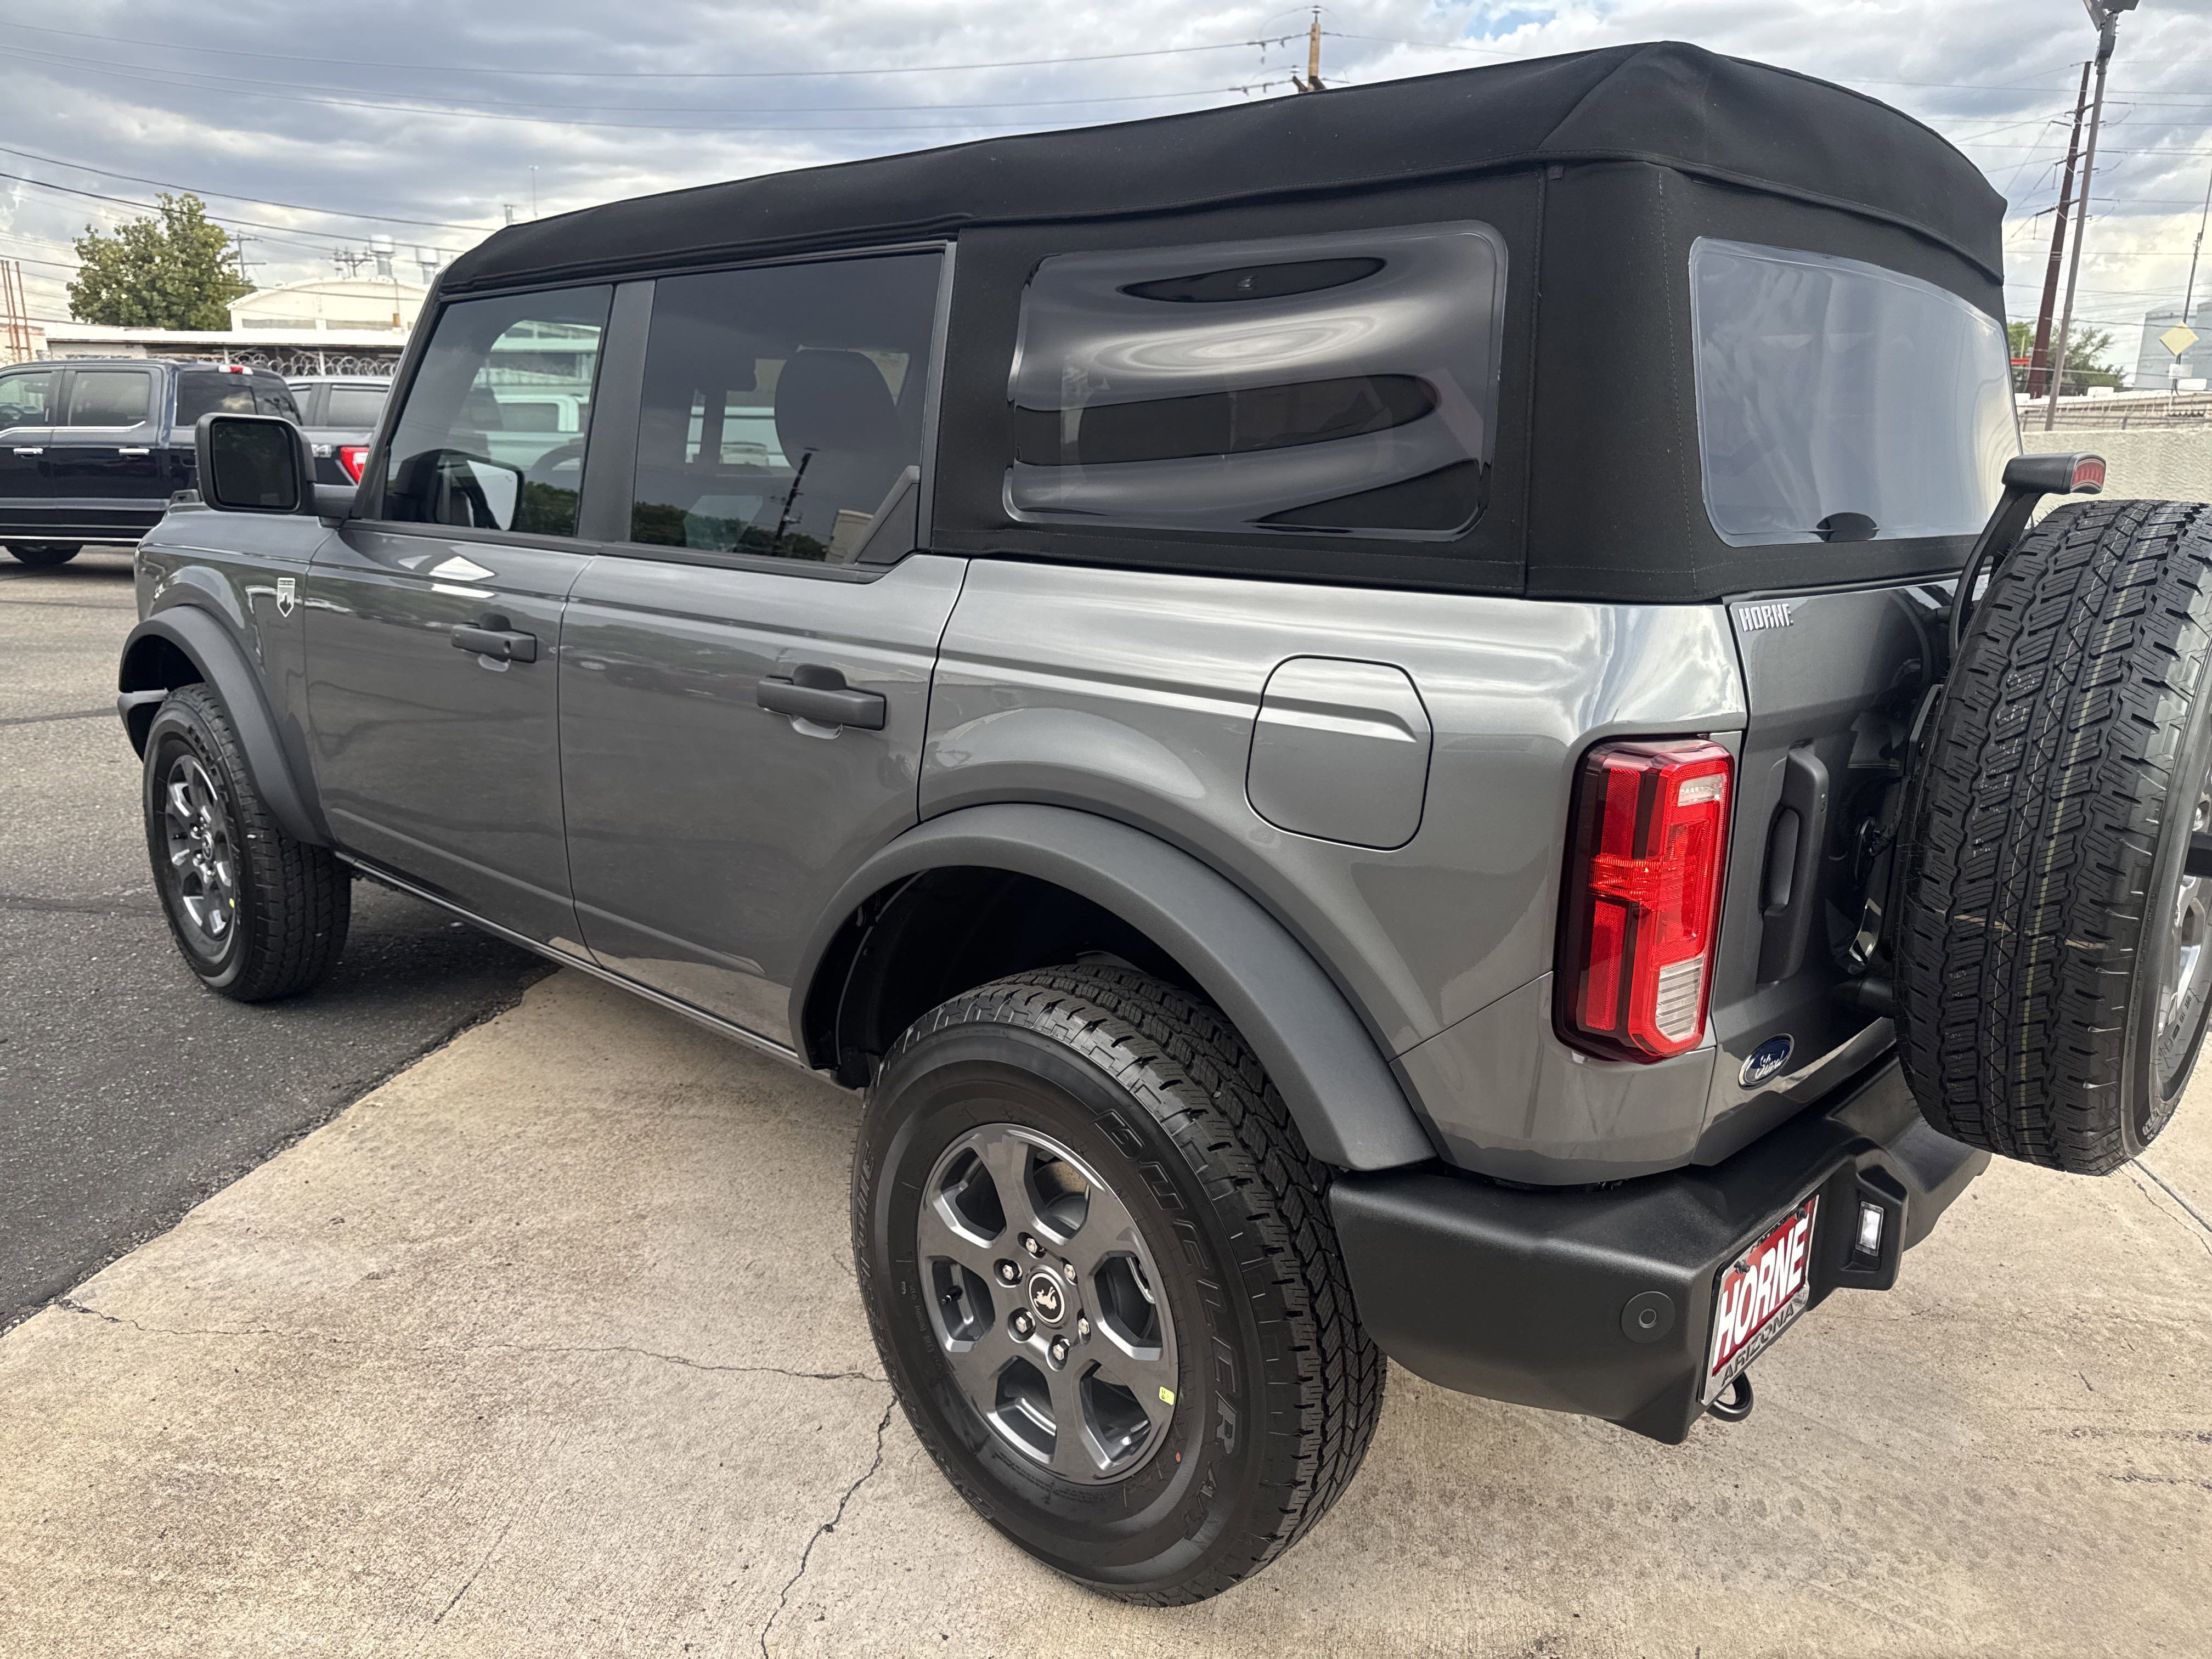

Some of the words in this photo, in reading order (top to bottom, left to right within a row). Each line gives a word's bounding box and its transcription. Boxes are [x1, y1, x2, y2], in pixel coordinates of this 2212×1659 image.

[1738, 603, 1794, 631] HORNE
[1093, 1108, 1239, 1455] DUELER
[1712, 1213, 1810, 1368] HORNE
[1721, 1303, 1795, 1387] ARIZONA
